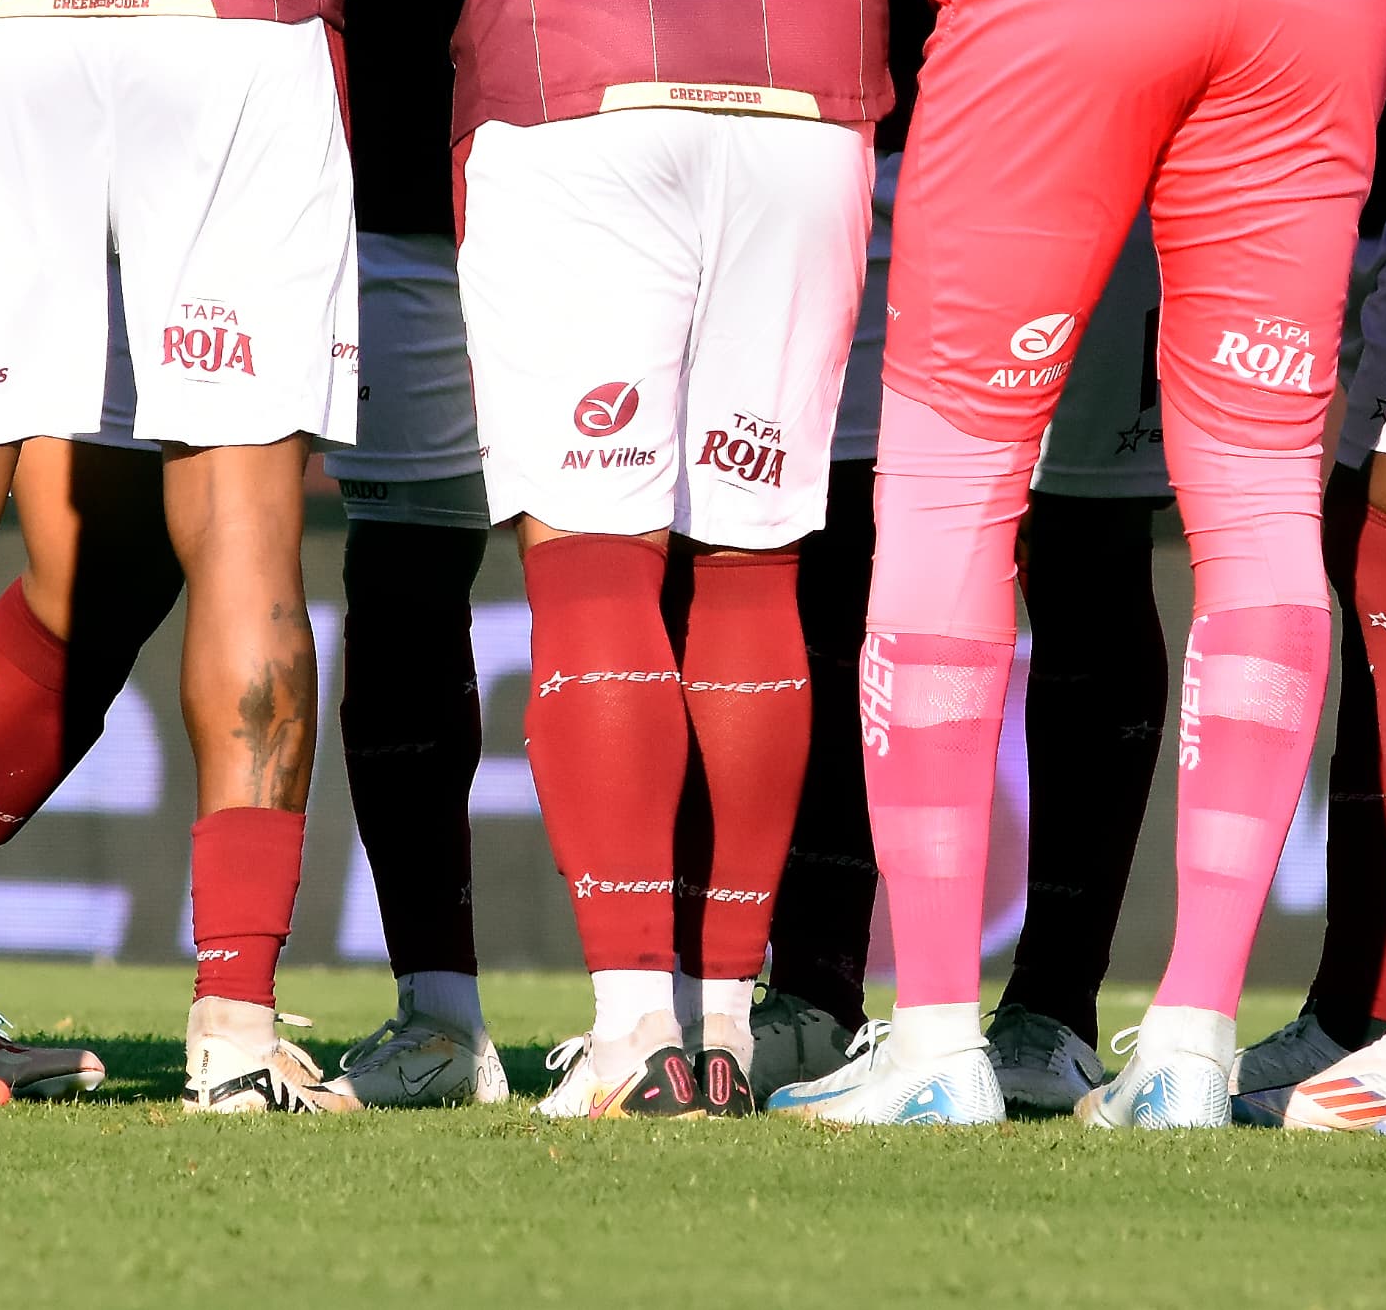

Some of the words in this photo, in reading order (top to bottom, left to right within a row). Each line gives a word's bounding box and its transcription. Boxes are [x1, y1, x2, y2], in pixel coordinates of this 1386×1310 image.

[181, 302, 239, 326] TAPA
[1254, 318, 1311, 348] TAPA
[161, 324, 257, 378] ROJA
[1210, 329, 1316, 394] ROJA
[986, 369, 1020, 389] AV
[733, 412, 783, 445] TAPA
[560, 449, 595, 471] AV
[598, 445, 657, 470] Villas
[694, 429, 788, 490] ROJA
[687, 676, 808, 694] SHEFFY
